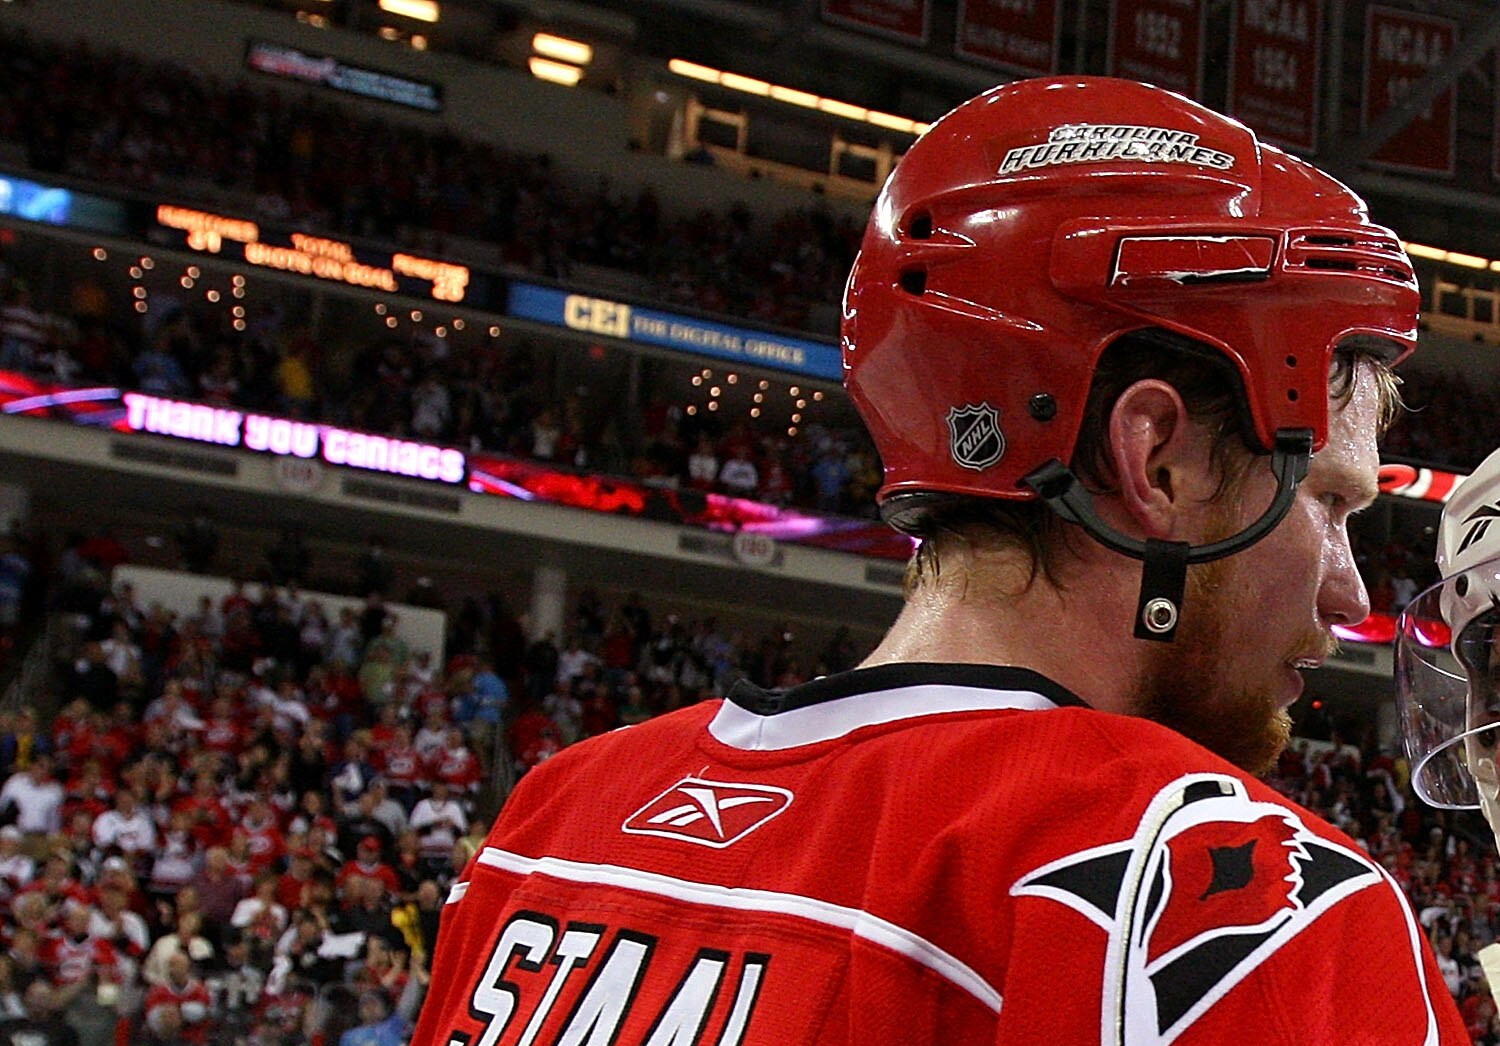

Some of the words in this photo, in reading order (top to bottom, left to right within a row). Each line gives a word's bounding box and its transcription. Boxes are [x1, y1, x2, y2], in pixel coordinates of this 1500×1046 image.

[1047, 125, 1201, 144] CAROLINA
[999, 140, 1235, 175] HURRICANES
[564, 293, 632, 339] CEI
[669, 322, 743, 351] DIGITAL
[744, 339, 806, 365] OFFICE
[960, 421, 991, 457] NHL
